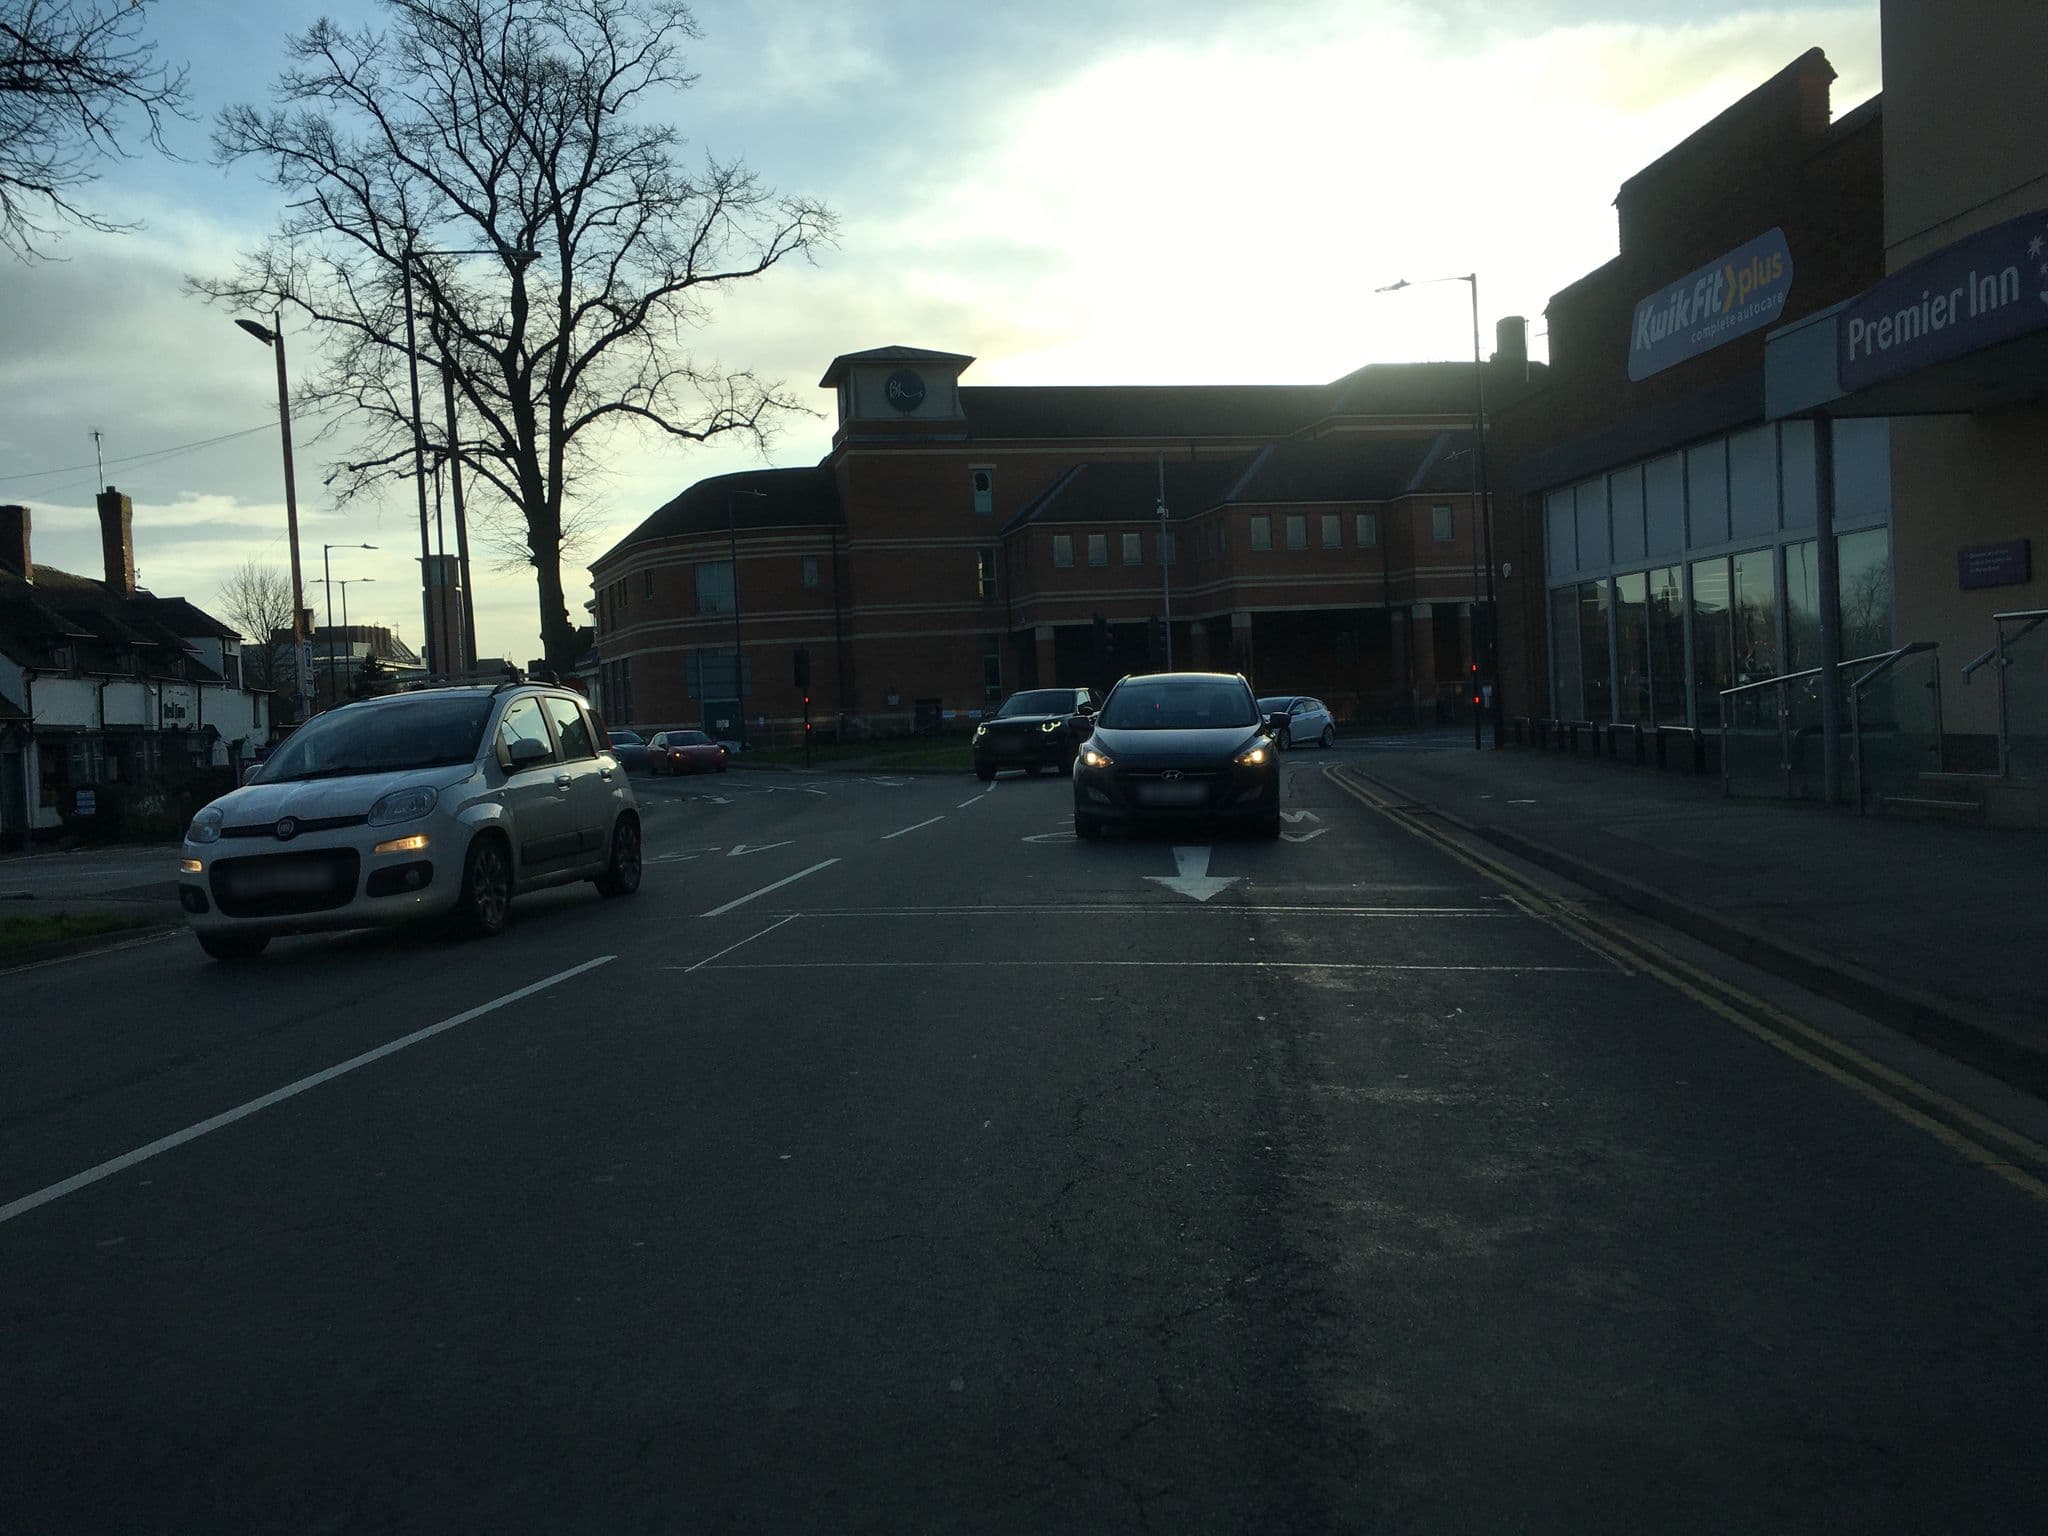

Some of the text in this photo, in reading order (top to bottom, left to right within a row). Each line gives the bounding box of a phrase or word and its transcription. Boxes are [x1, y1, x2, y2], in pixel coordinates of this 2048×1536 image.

[1739, 252, 1784, 305] plus
[1691, 290, 1784, 343] complete autocare
[1848, 266, 2020, 361] Premier Inn
